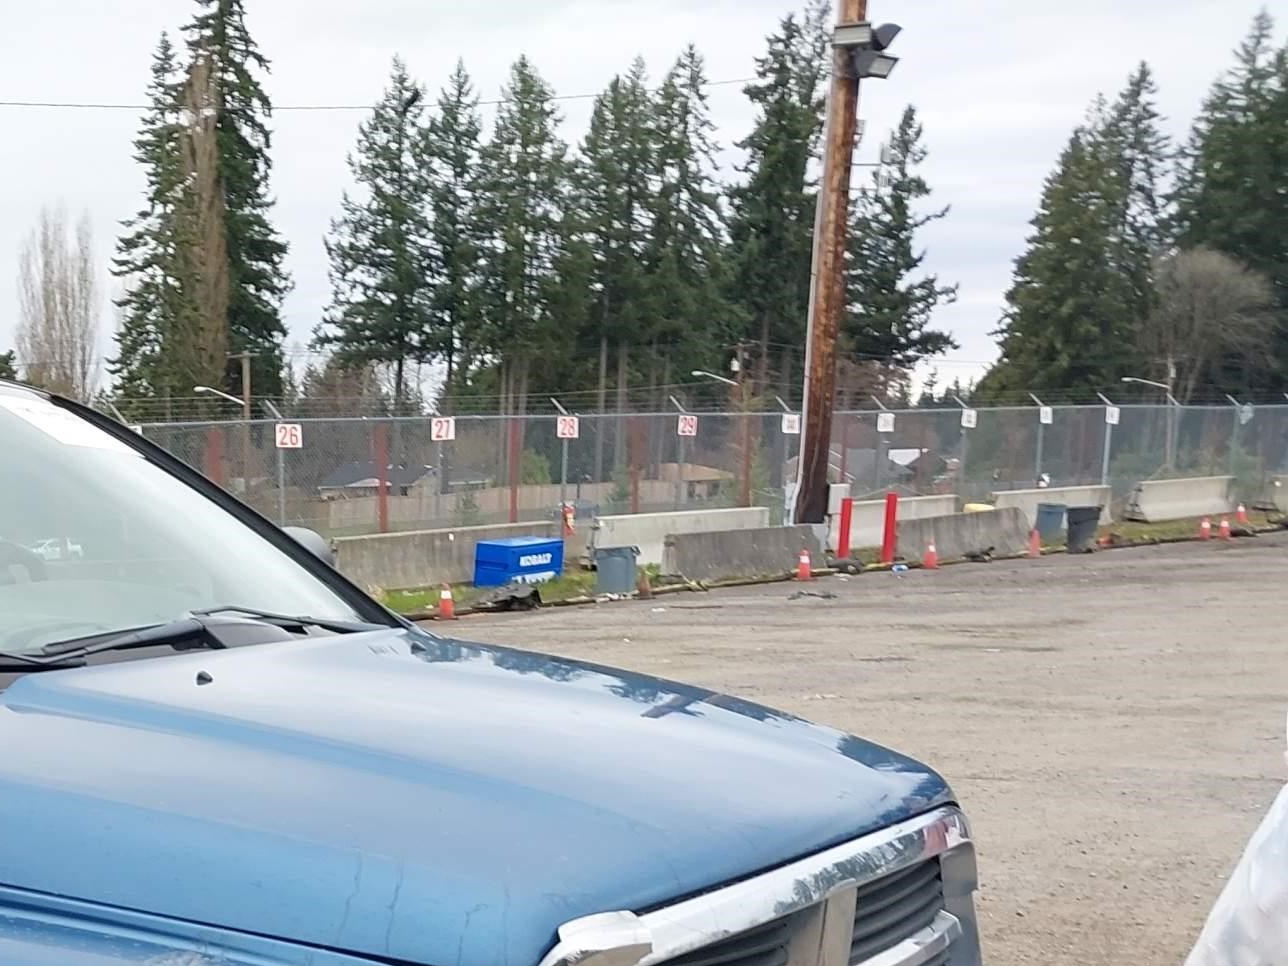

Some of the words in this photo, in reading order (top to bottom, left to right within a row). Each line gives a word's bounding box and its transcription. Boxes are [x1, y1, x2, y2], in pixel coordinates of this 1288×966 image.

[434, 419, 451, 439] 27
[560, 418, 575, 436] 28
[681, 416, 694, 434] 29
[279, 426, 299, 446] 26
